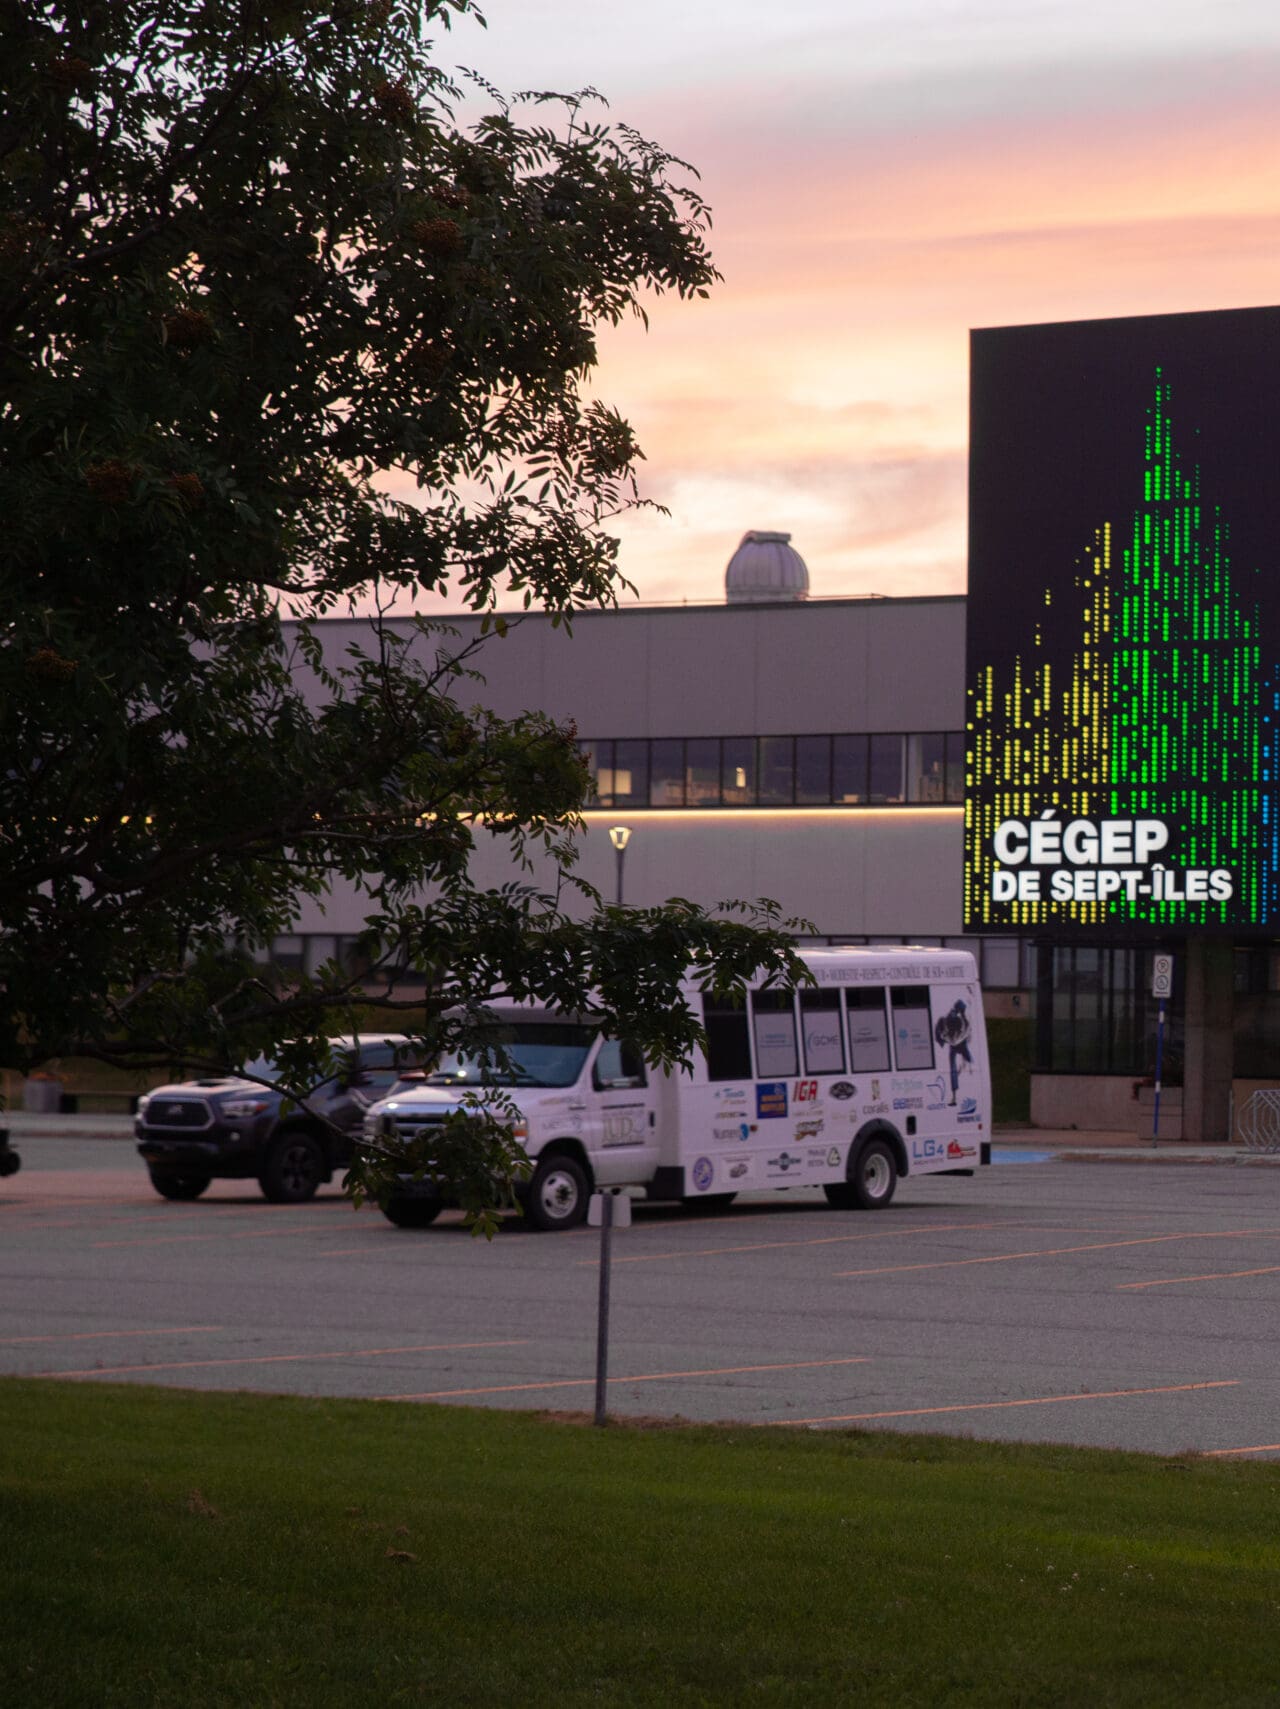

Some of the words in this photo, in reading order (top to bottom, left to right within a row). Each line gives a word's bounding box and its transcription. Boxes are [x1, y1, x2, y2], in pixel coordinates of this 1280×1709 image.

[993, 809, 1169, 864] CÉGEP
[992, 871, 1041, 901] DE
[1051, 864, 1233, 901] SEPT-ÎLES
[793, 1080, 818, 1102] IGA
